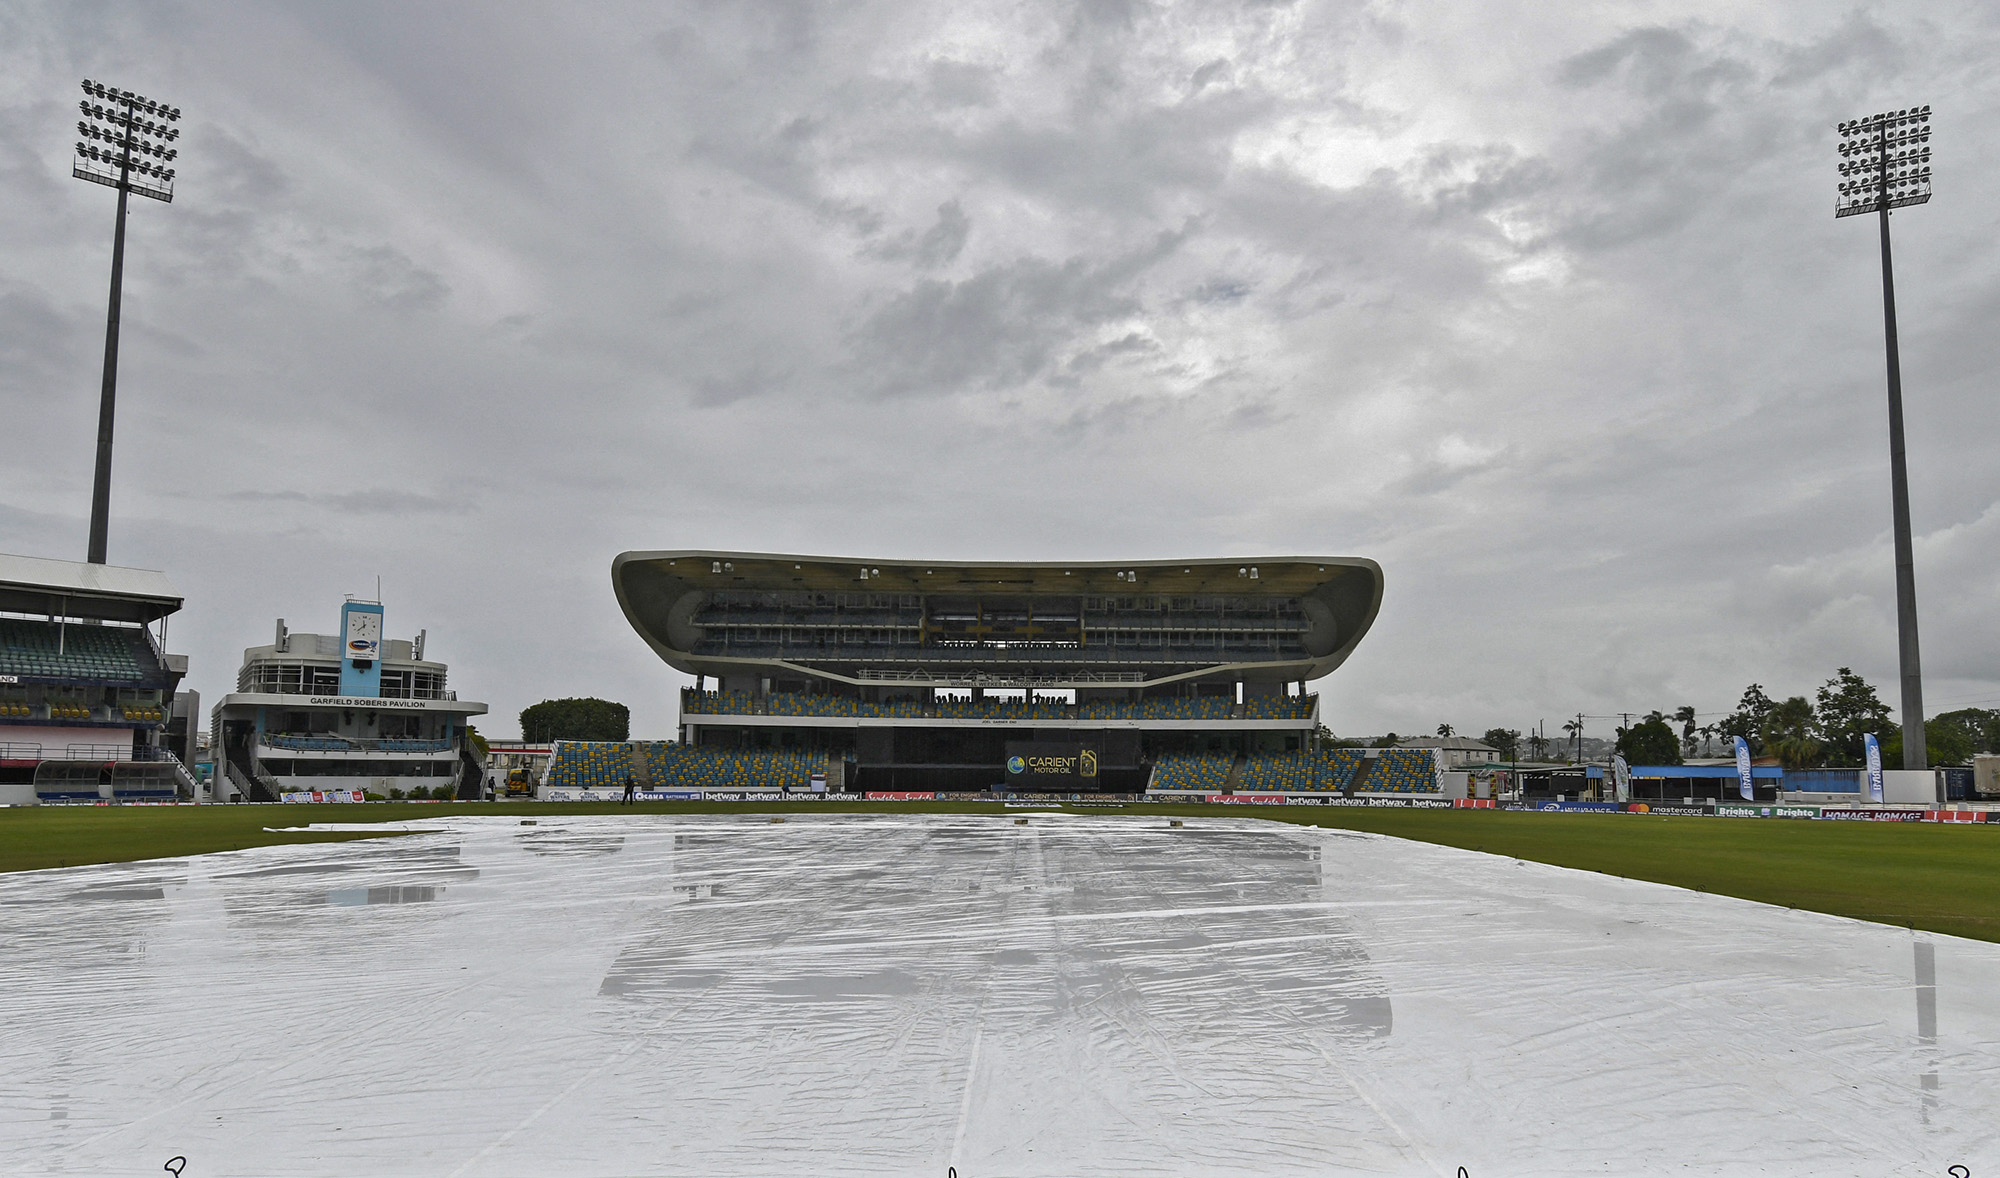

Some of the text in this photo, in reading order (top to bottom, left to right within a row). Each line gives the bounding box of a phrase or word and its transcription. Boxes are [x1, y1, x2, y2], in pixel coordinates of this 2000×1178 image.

[310, 697, 426, 708] GARFIELD SOBERS PAVILION
[1028, 757, 1077, 767] CARIENT
[706, 792, 741, 800] betway
[746, 793, 781, 801] betway
[786, 792, 821, 800] betway
[825, 792, 858, 800] betway
[1286, 797, 1321, 805] betway
[1329, 797, 1365, 806] betway
[1369, 798, 1405, 807] betway
[1412, 799, 1451, 808] betway
[1652, 806, 1703, 814] mastercard
[1719, 807, 1814, 817] Brighto Brighto
